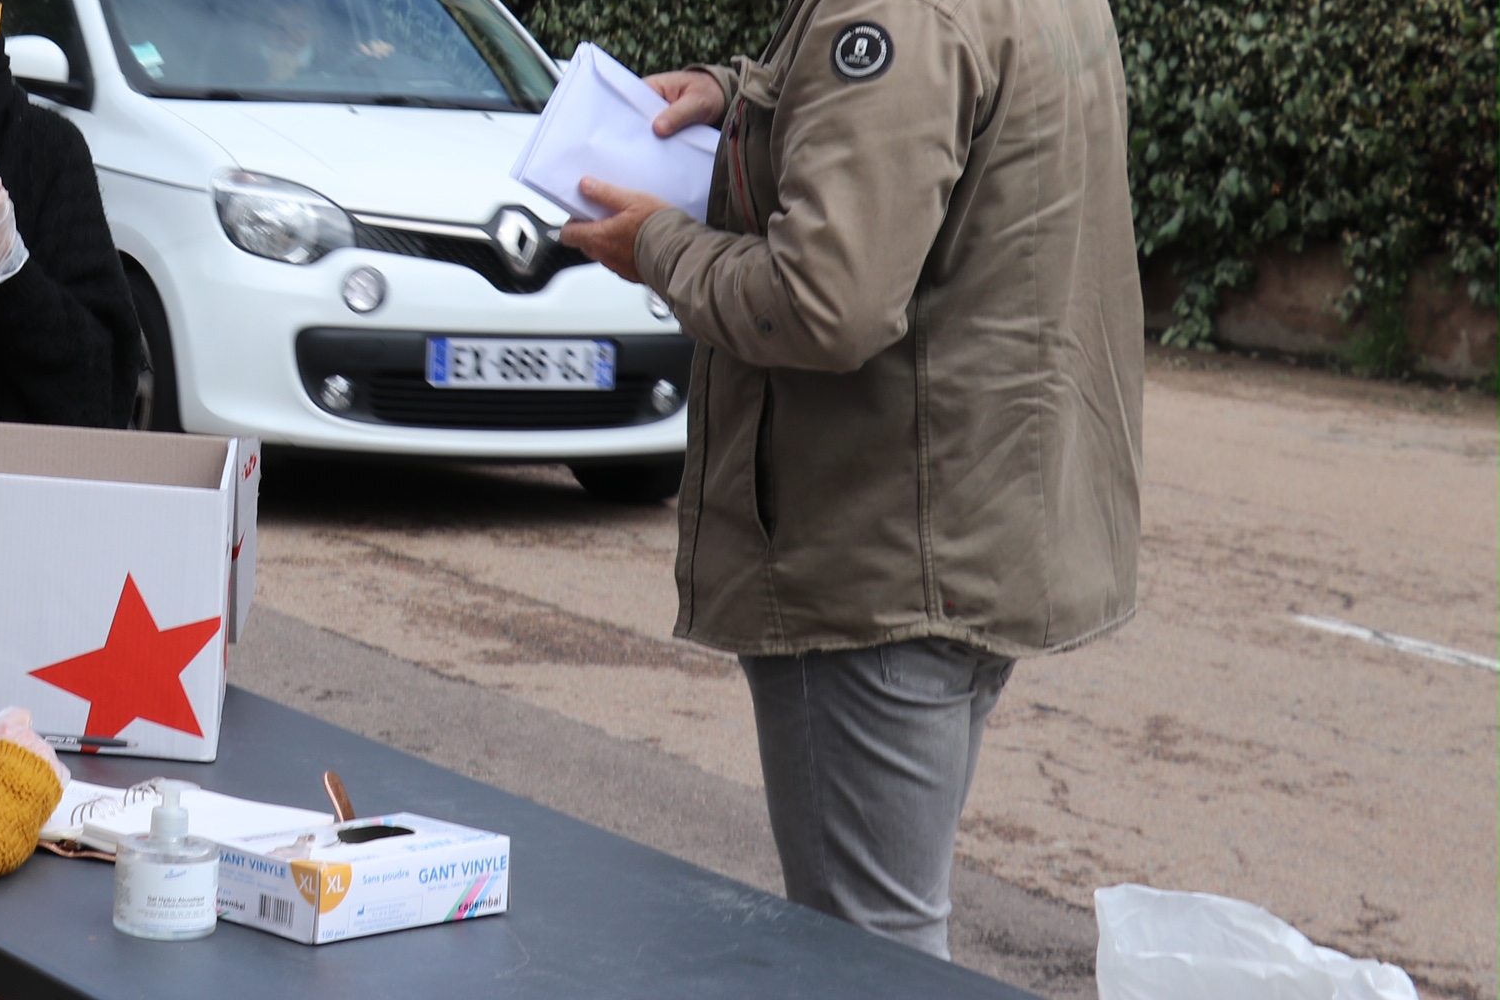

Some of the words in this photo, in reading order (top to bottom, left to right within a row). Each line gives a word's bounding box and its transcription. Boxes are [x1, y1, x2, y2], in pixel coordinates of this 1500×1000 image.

[249, 858, 287, 879] VINYLE
[362, 874, 380, 885] Sans
[382, 868, 410, 884] poudre
[418, 862, 457, 884] GANT
[461, 854, 507, 877] VINYLE
[299, 873, 316, 894] XL
[326, 874, 345, 895] XL
[458, 894, 502, 912] capembal
